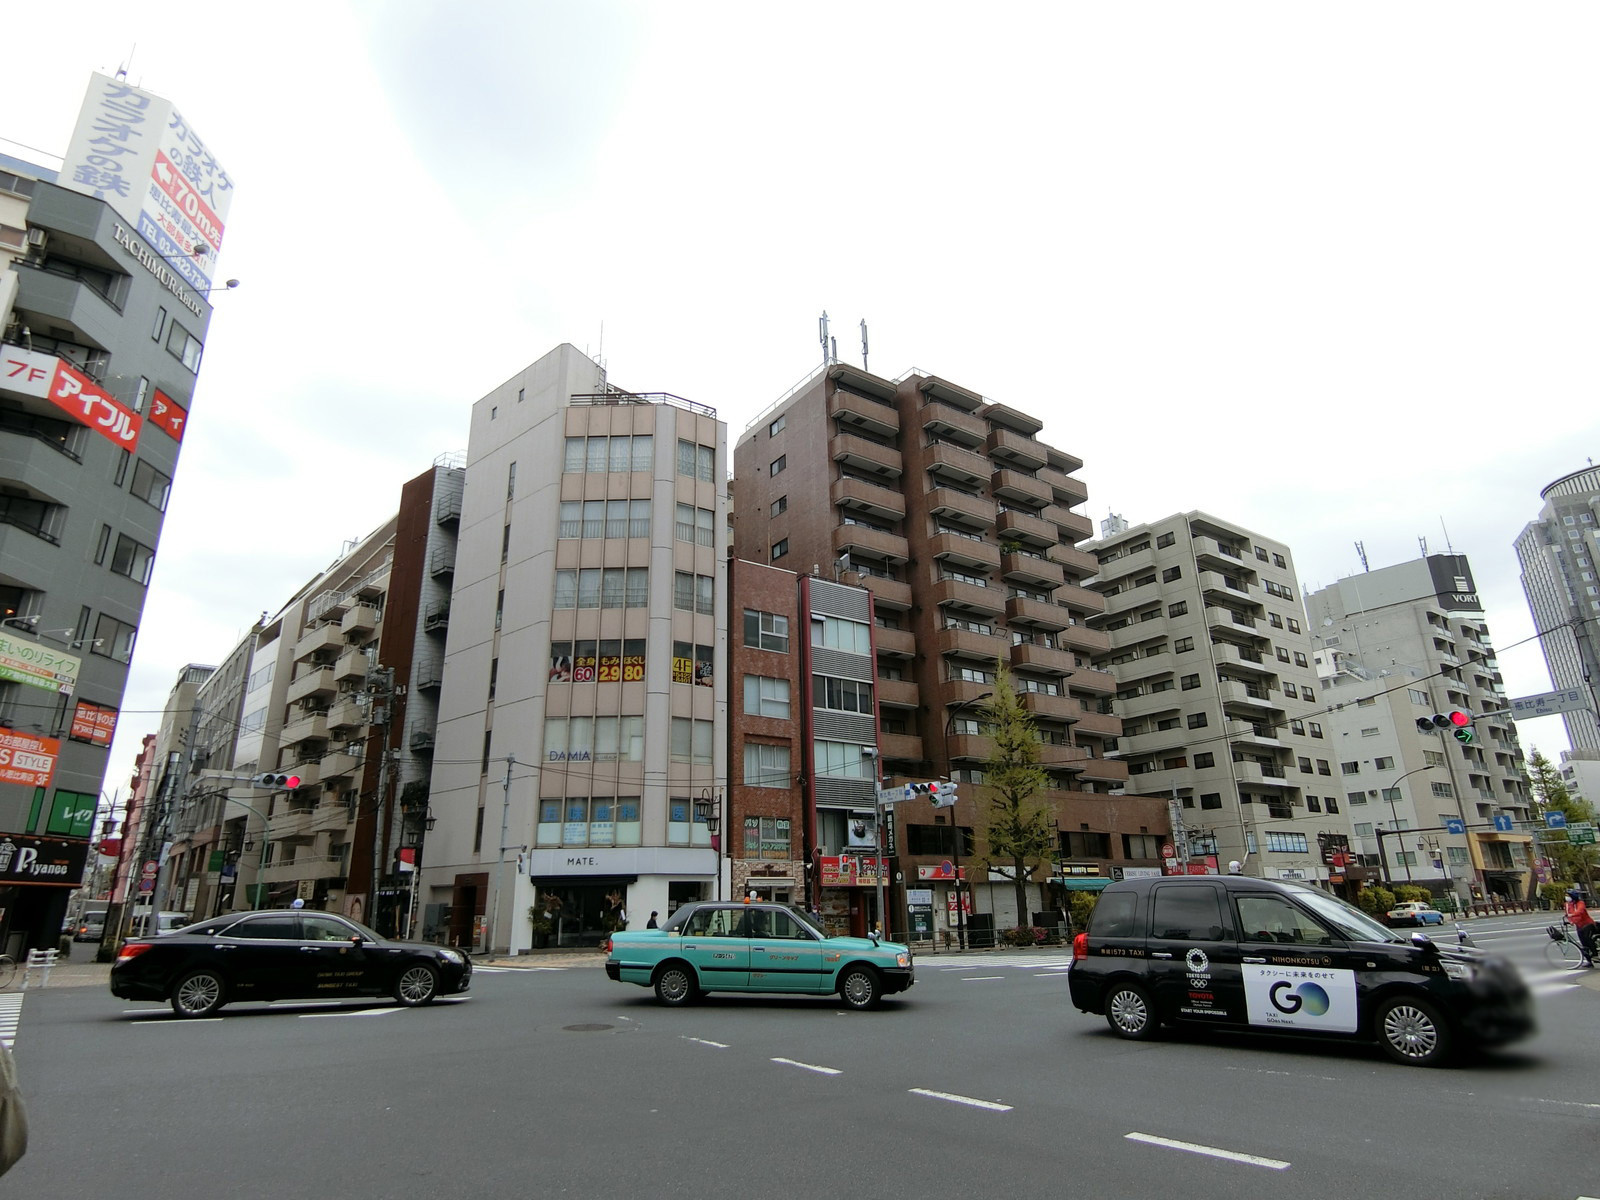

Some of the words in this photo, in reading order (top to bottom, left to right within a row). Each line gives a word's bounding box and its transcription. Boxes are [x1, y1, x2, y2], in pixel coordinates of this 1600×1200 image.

[168, 111, 234, 192] カラオケ
[169, 146, 217, 211] の鉄人
[175, 177, 223, 246] 70m先
[140, 216, 158, 244] TEL
[7, 359, 48, 382] 7F
[57, 370, 136, 441] アイフル
[1452, 594, 1478, 603] VORT
[575, 656, 646, 667] 全身もみほぐし
[674, 659, 691, 672] 4F
[574, 667, 594, 682] 60
[599, 665, 643, 682] 2,980
[1514, 691, 1579, 711] 恵比寿一丁目
[16, 754, 49, 769] STYLE
[549, 750, 591, 761] DAMIA
[63, 806, 94, 822] レイク
[567, 857, 599, 866] MATE.
[1129, 949, 1145, 957] TAXI
[1272, 956, 1320, 965] NIHONKOTSU
[1260, 969, 1335, 979] タクシーに未来をのせて
[1188, 992, 1214, 1000] TOYOTA
